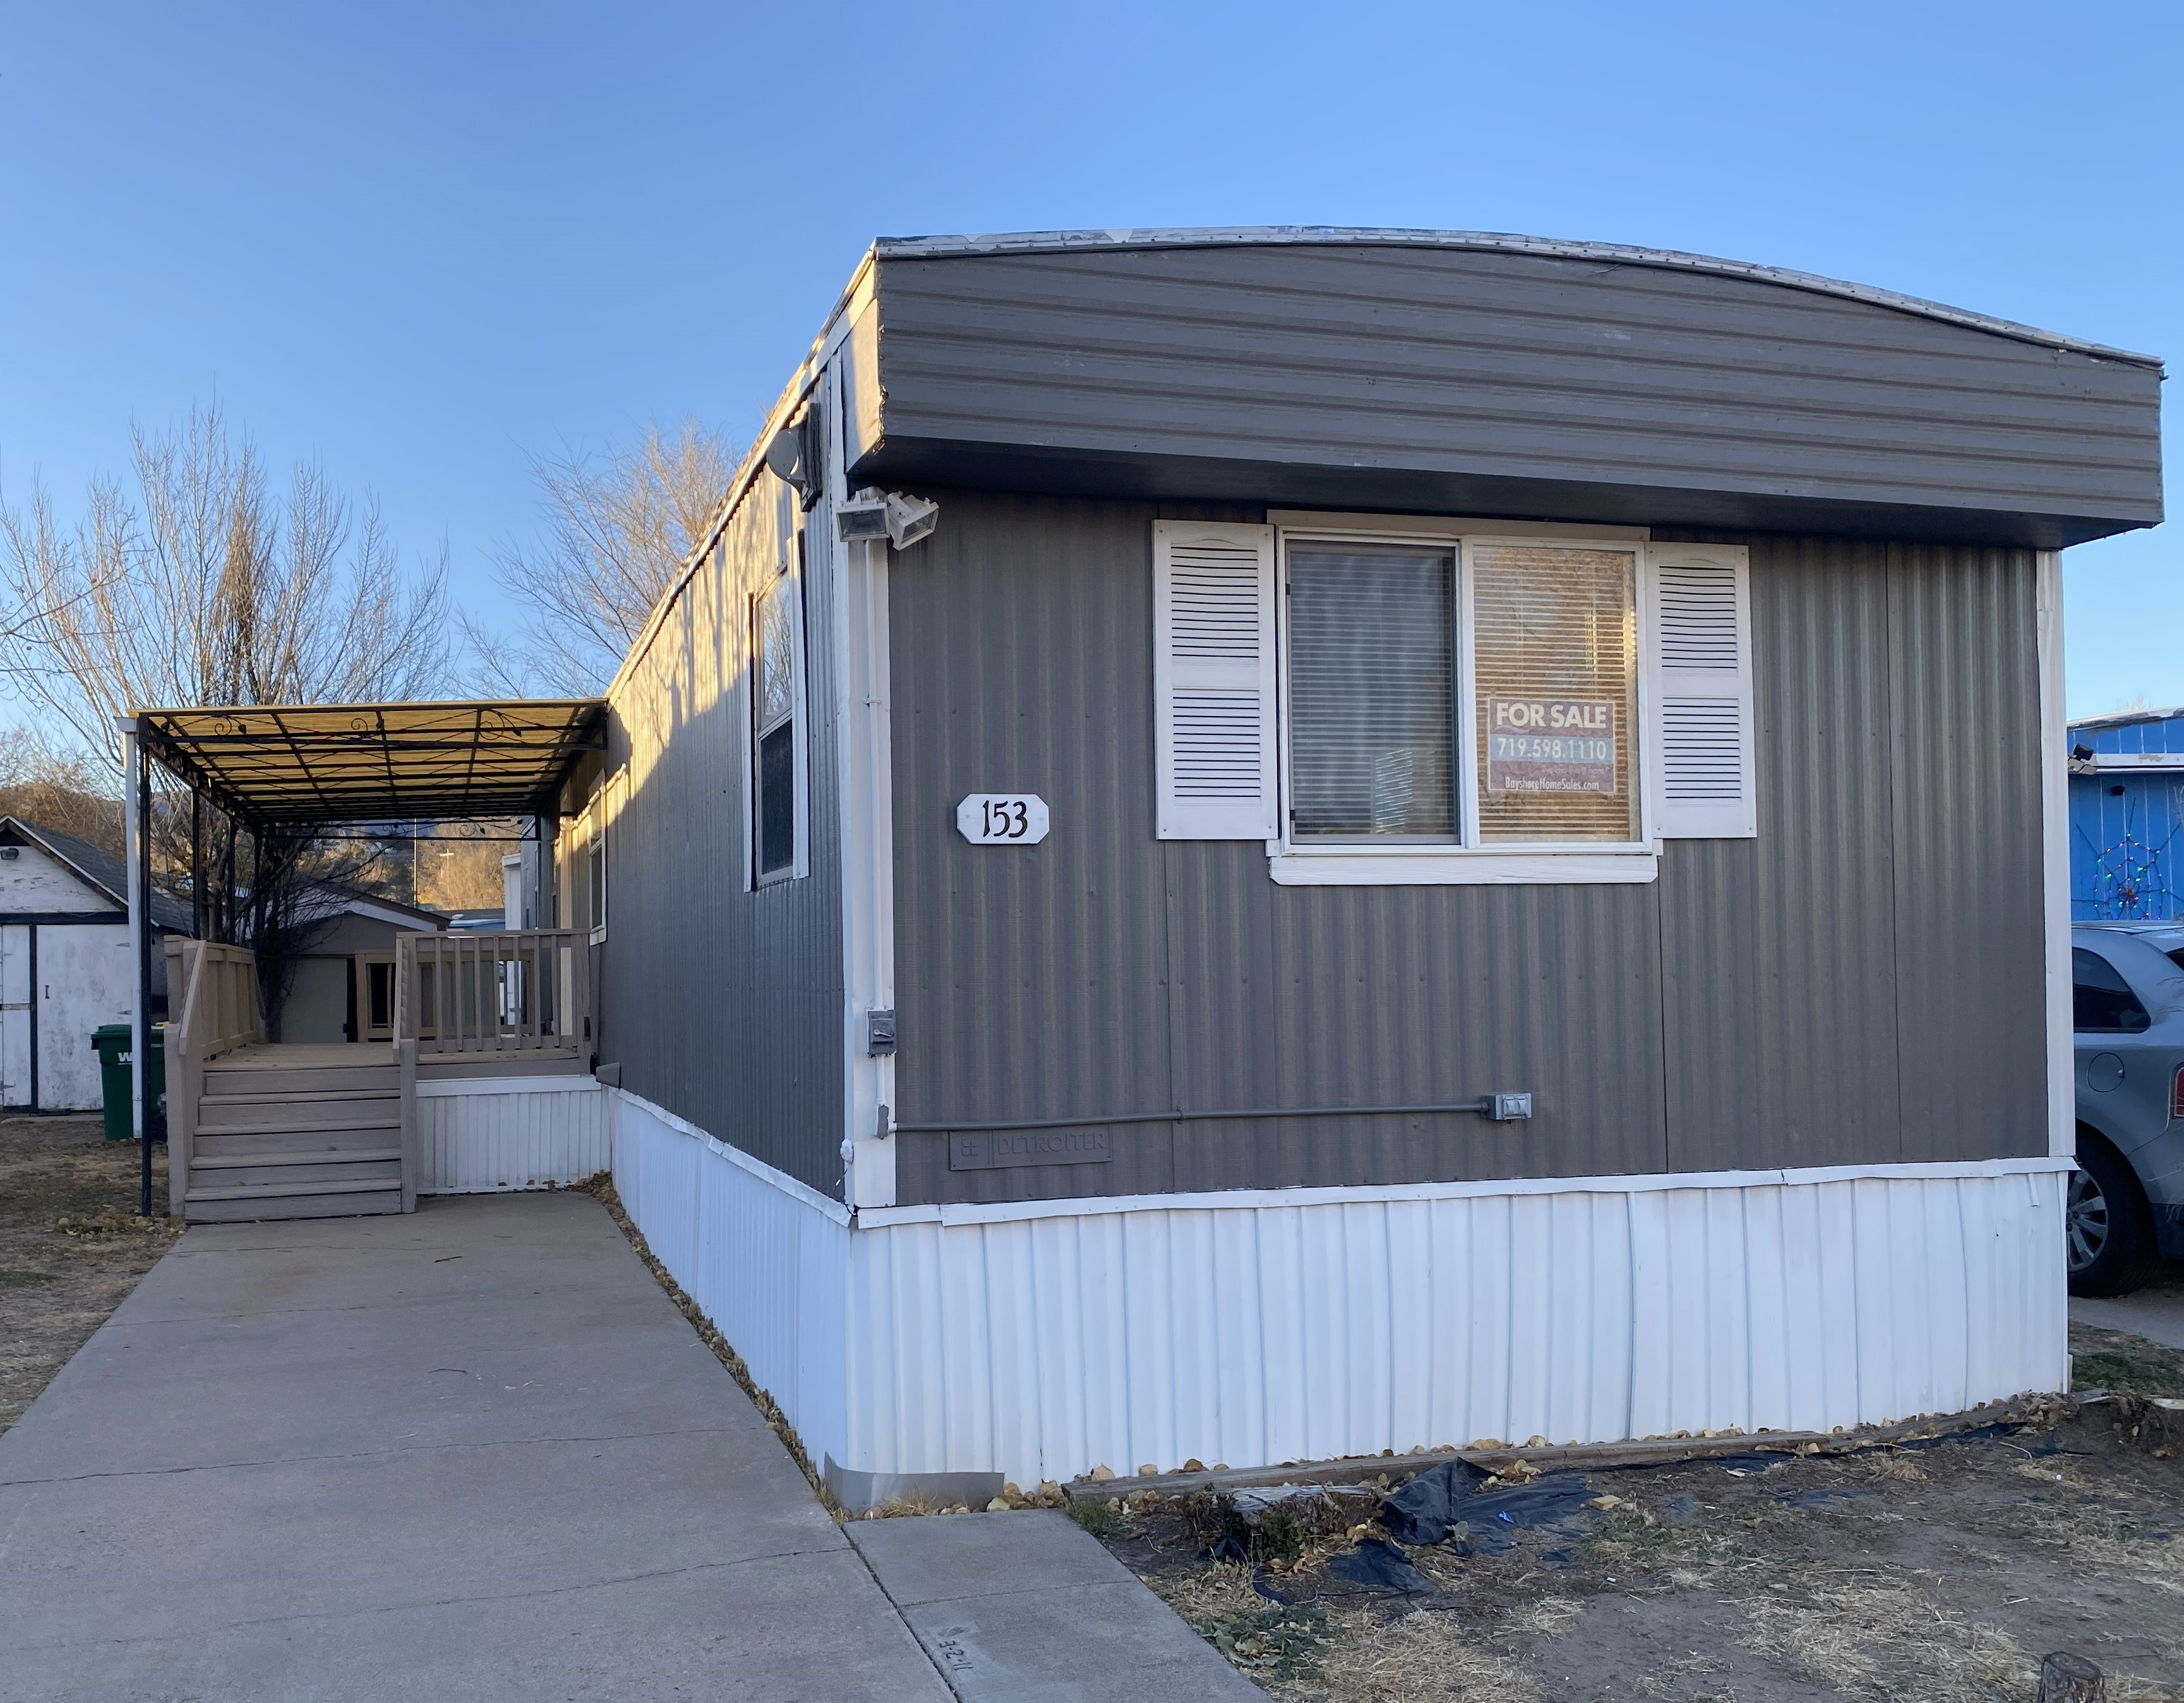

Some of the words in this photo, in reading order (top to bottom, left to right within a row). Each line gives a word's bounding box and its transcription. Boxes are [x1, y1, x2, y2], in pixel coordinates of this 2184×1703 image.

[1496, 703, 1546, 727] FOR
[1550, 705, 1607, 729] SALE
[1497, 738, 1606, 760] 719.598.1110
[1505, 776, 1599, 791] BayshoreHomeSales.com
[982, 799, 1028, 838] 153
[997, 1131, 1107, 1155] DETROITER
